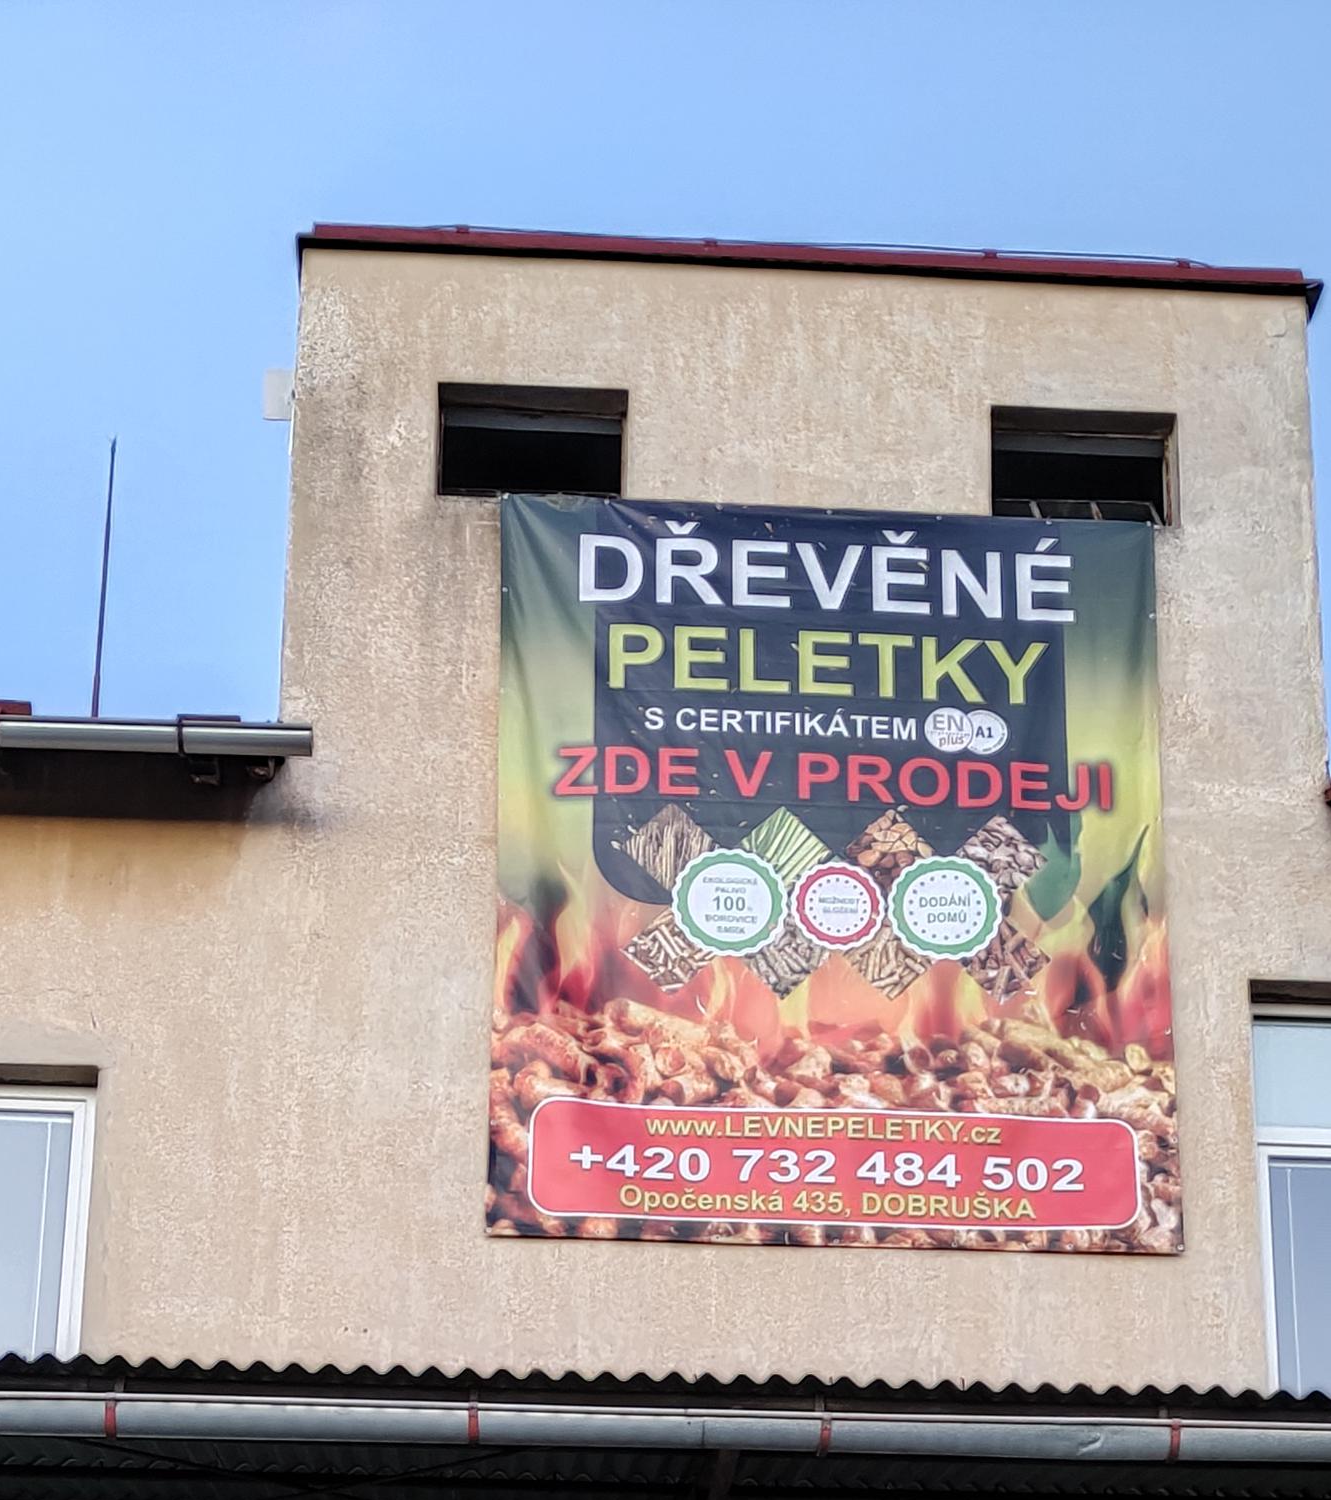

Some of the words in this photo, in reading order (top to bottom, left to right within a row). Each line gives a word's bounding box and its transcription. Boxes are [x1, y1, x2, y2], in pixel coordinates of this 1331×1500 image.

[579, 520, 1075, 622] DŘEVĚNÉ
[608, 624, 1049, 704] PELETKY
[644, 706, 664, 731] S
[675, 707, 917, 741] CERTIFIKÁTEM
[932, 714, 964, 732] EN
[975, 726, 993, 738] A1
[939, 734, 965, 748] plus
[554, 746, 700, 796] ZDE
[723, 750, 772, 797] V
[798, 752, 1112, 811] PRODEJI
[712, 895, 745, 911] 100
[919, 892, 971, 908] DODÁNÍ
[927, 909, 967, 923] DOMŮ
[646, 1115, 1001, 1144] www.LEVNEPELETKY.cz
[569, 1144, 710, 1182] +420
[732, 1148, 836, 1184] 732
[856, 1151, 962, 1188] 484
[982, 1156, 1085, 1192] 502
[620, 1185, 784, 1213] Opočenská
[793, 1190, 851, 1217] 435,
[861, 1191, 1037, 1219] DOBRUŠKA
